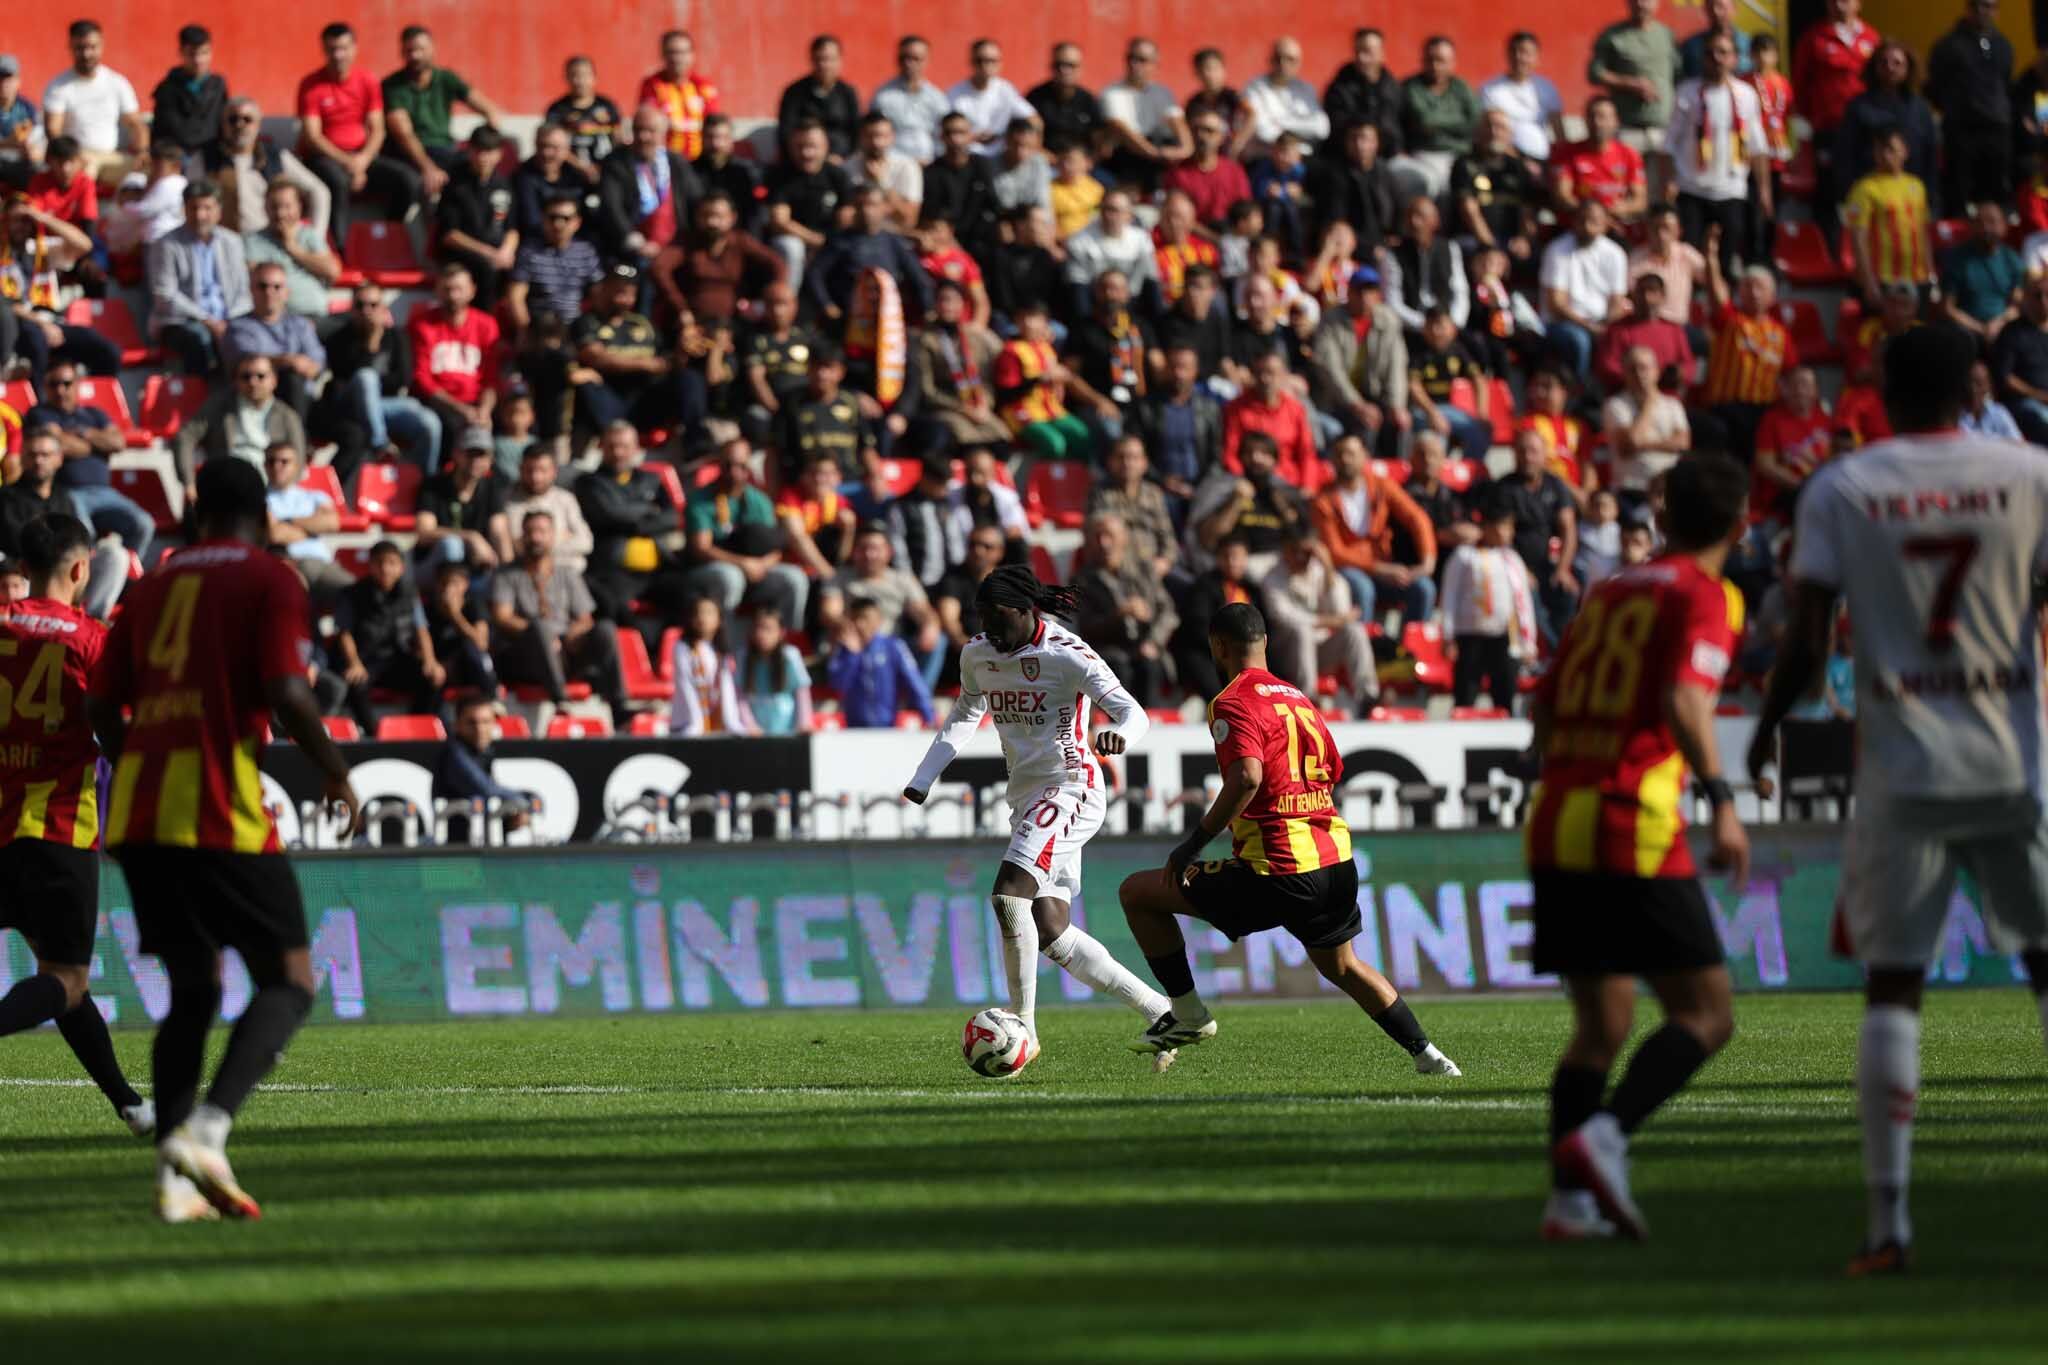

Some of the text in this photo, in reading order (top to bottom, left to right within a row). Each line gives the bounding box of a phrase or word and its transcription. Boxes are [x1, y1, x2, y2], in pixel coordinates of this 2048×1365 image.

[149, 575, 203, 683] 4
[1902, 533, 1981, 652] 7
[983, 690, 1048, 712] OREX
[1556, 595, 1657, 718] 28
[994, 713, 1045, 726] OLDING
